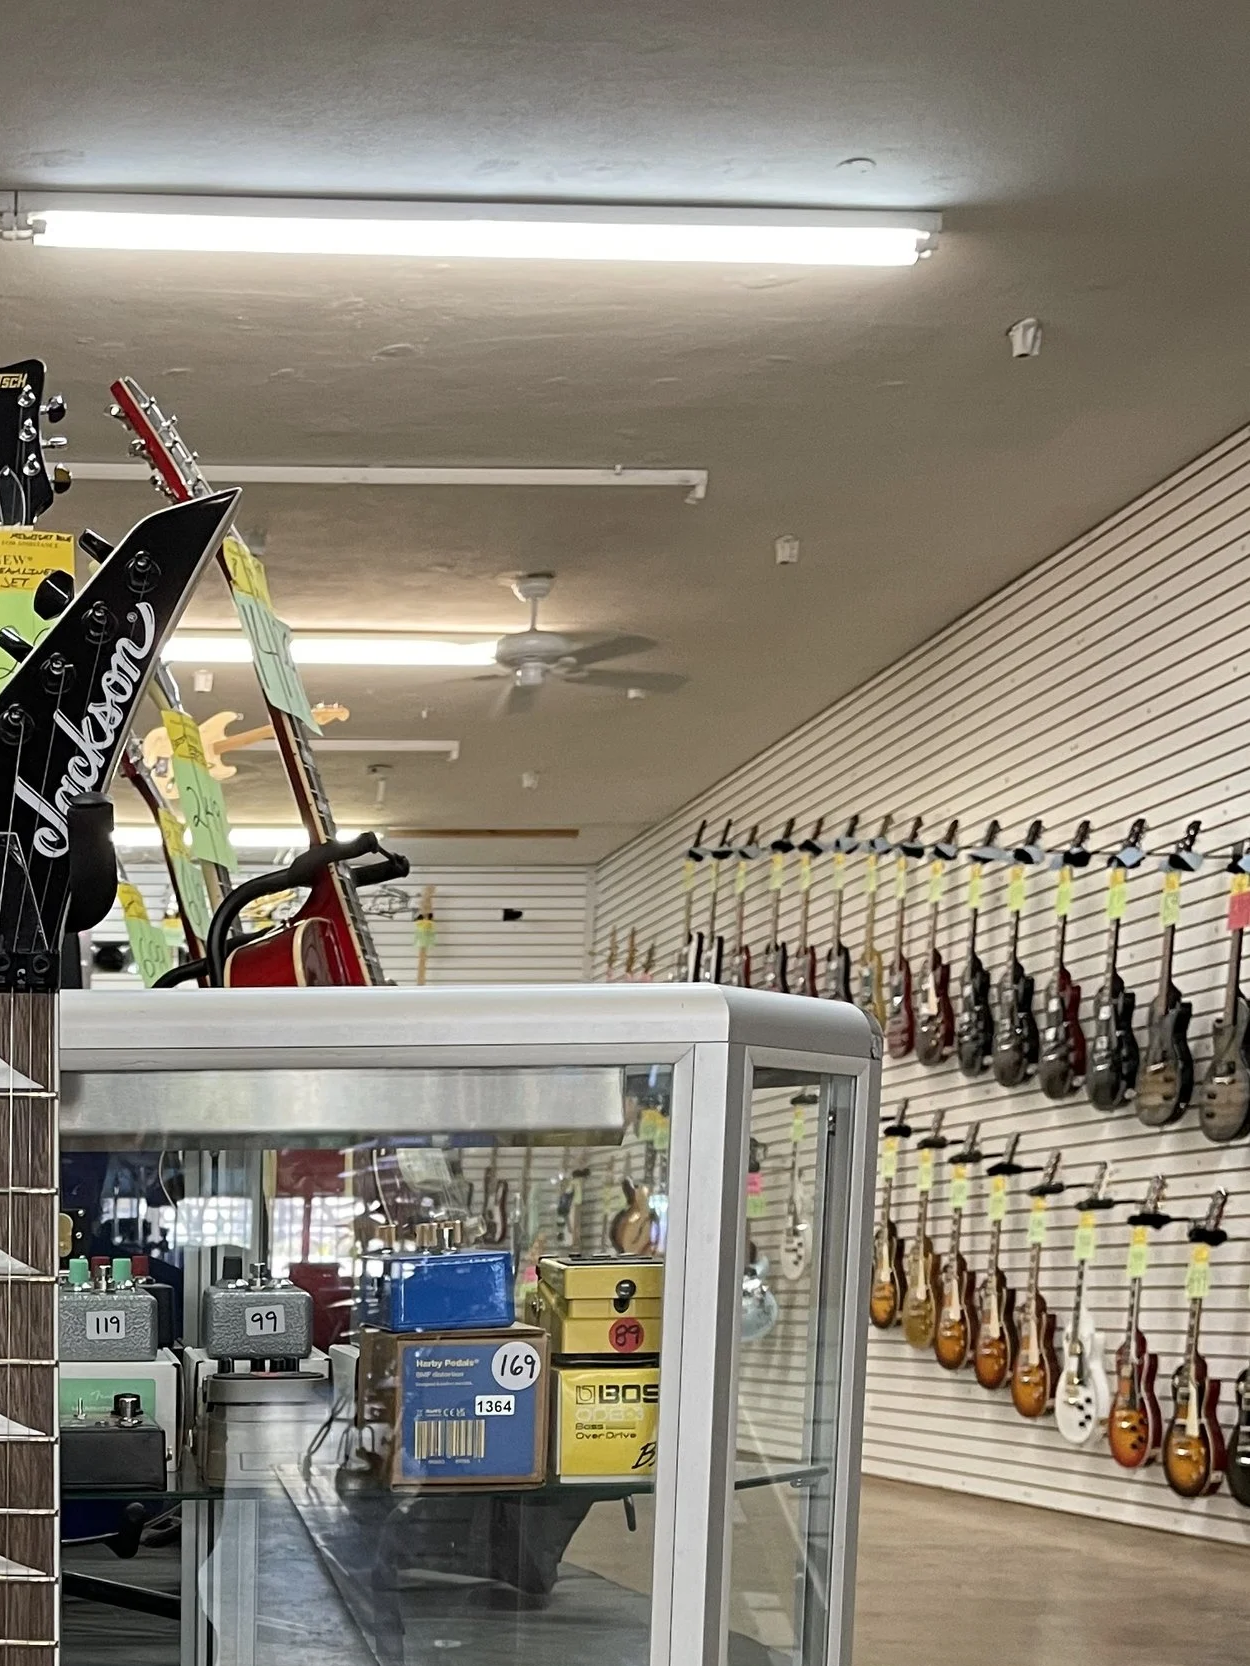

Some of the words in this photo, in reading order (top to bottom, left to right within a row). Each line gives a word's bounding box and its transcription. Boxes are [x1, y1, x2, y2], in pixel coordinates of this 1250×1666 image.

[0, 577, 30, 588] JET
[13, 602, 156, 858] Jackson
[96, 1316, 120, 1335] 119
[251, 1311, 277, 1332] 99
[615, 1324, 640, 1347] 89
[501, 1354, 536, 1379] 169
[598, 1384, 659, 1404] BOS
[477, 1400, 512, 1413] 1364
[576, 1422, 604, 1430] Bass
